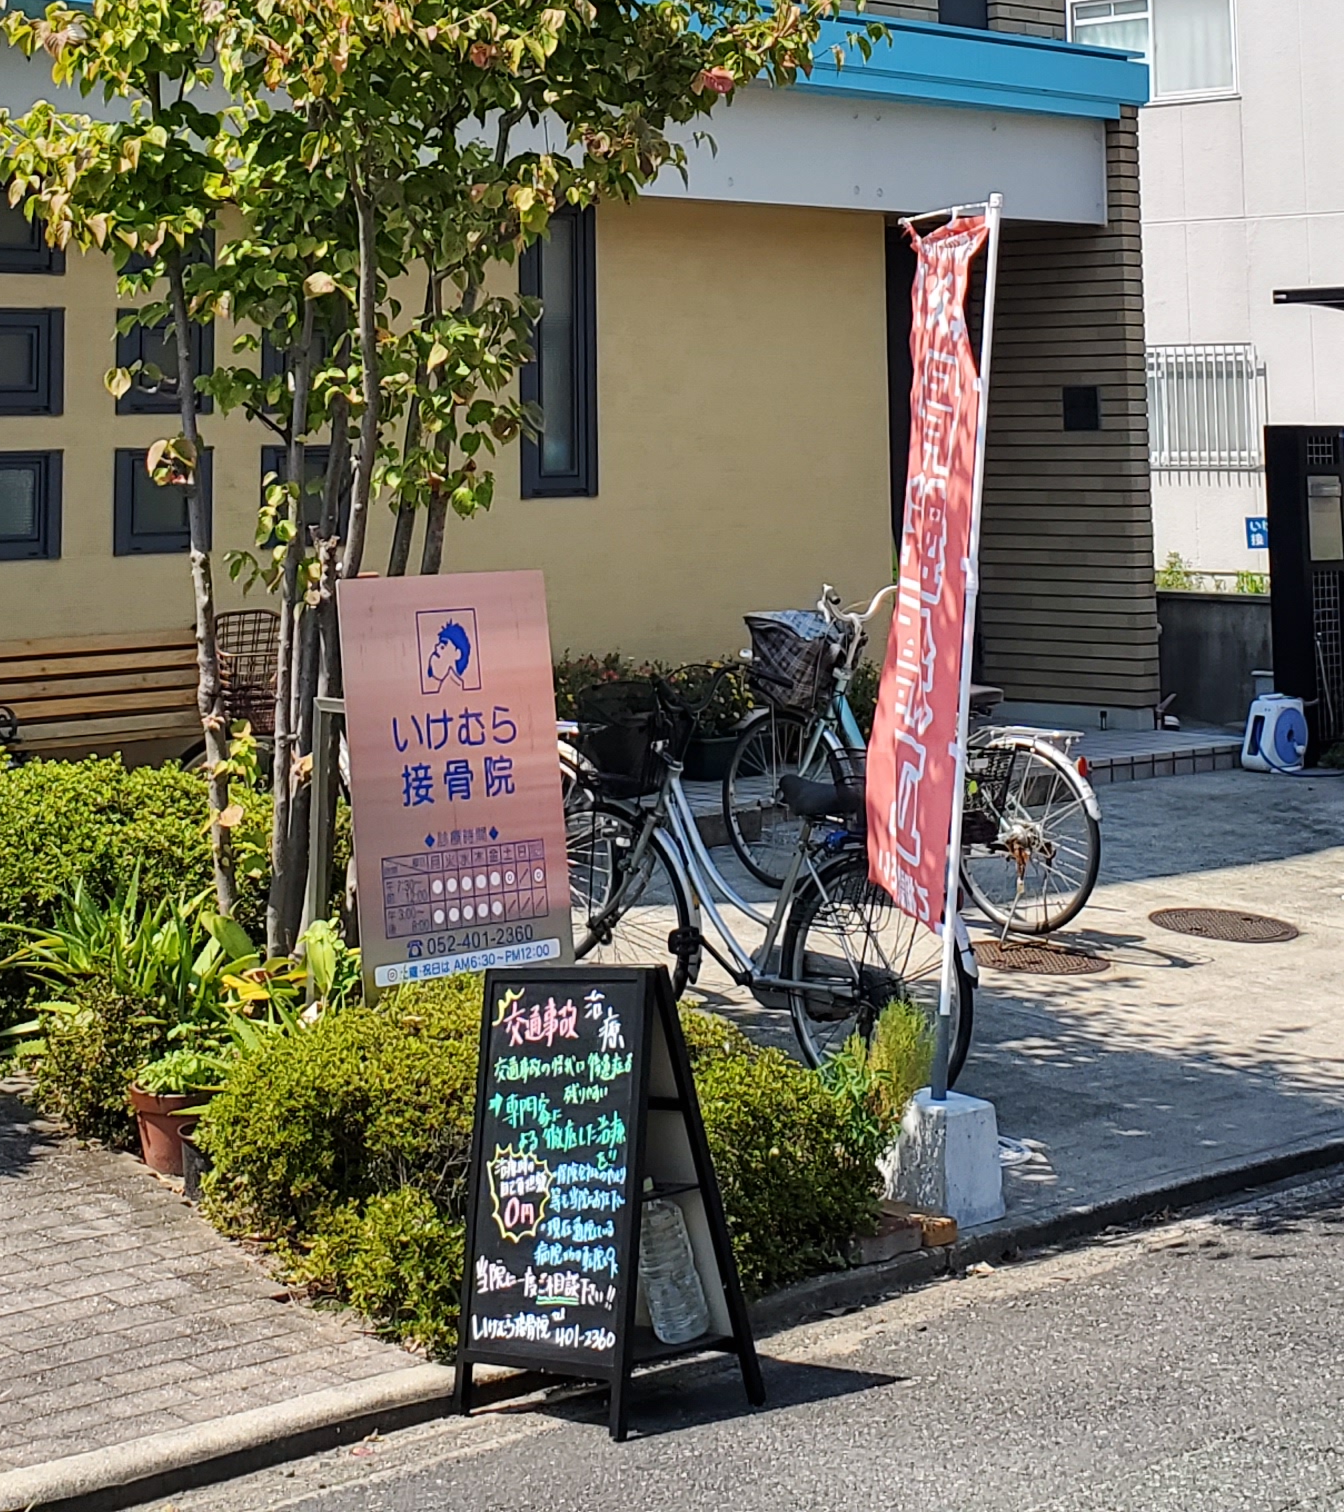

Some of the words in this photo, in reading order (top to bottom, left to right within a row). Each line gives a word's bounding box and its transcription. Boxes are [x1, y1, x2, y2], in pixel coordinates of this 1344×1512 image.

[392, 706, 517, 753] いけむら
[401, 755, 516, 807] 接骨院
[488, 848, 500, 864] 金
[427, 924, 534, 955] 052-401-2360
[503, 996, 579, 1047] 交通事故
[584, 989, 625, 1052] 治療
[504, 1197, 535, 1228] 0円
[555, 1324, 616, 1351] 401-2360
